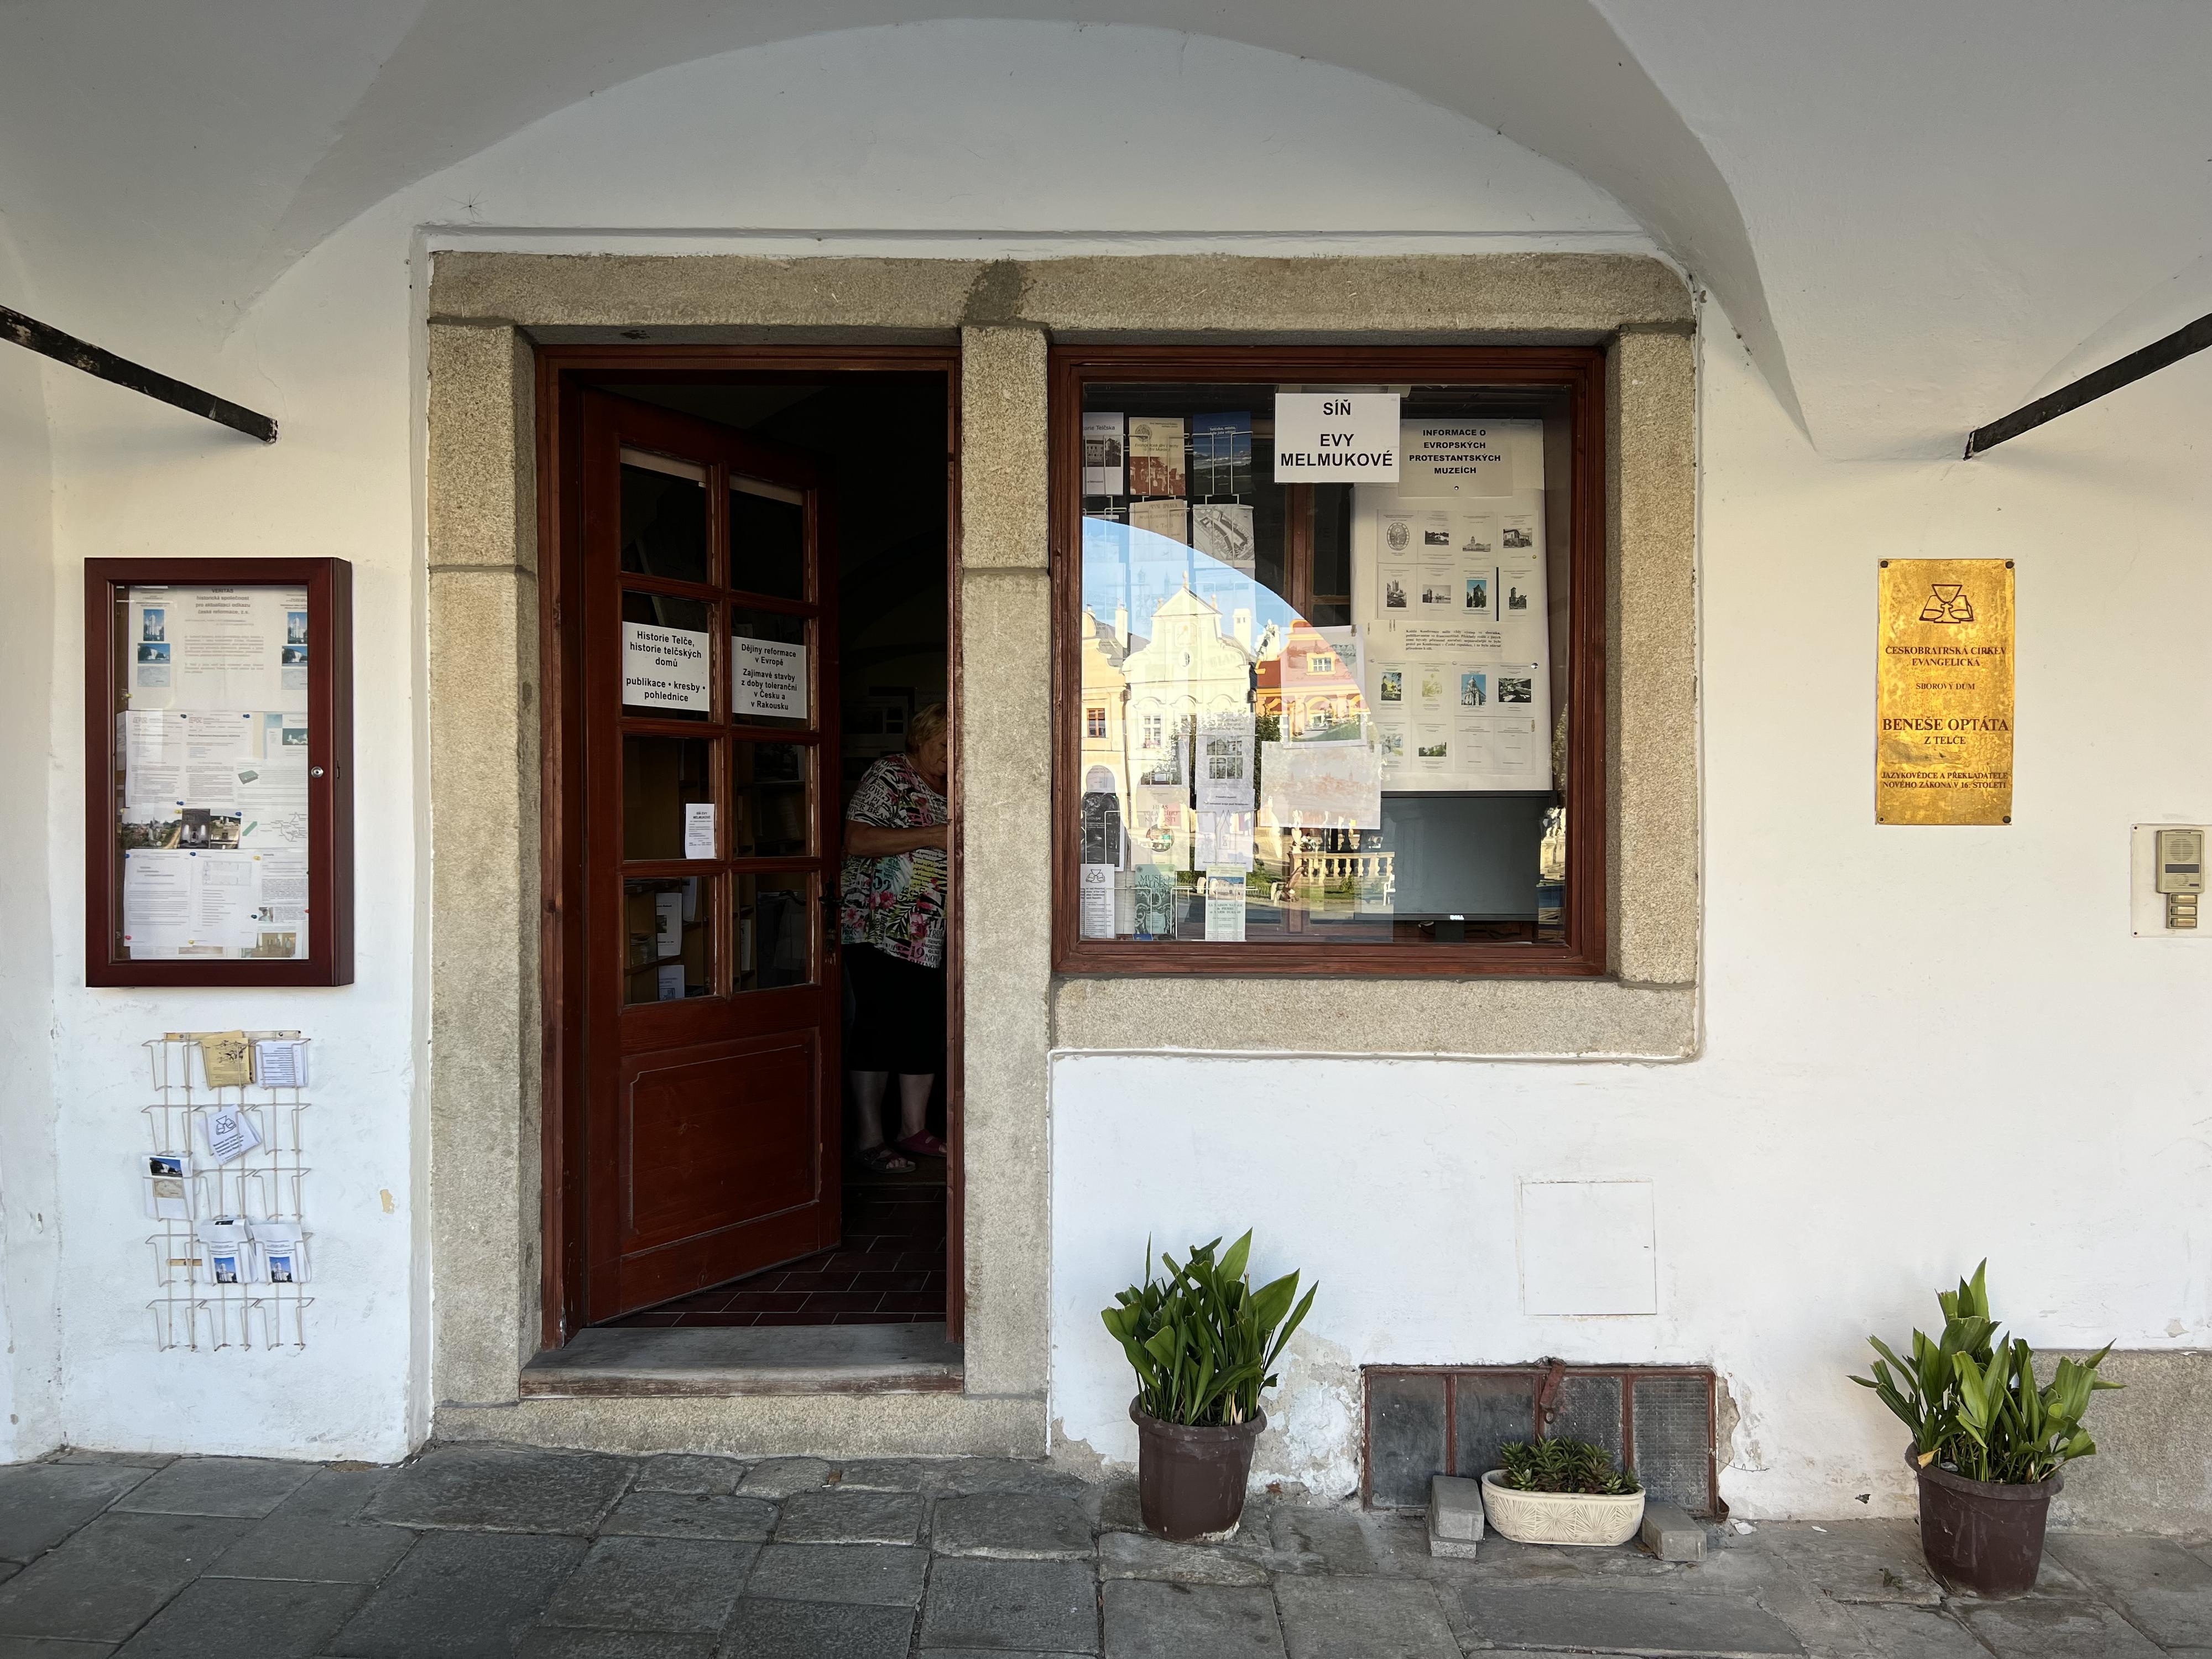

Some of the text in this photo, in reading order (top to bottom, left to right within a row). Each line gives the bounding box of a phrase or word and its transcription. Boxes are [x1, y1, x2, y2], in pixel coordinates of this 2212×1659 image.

[1323, 399, 1351, 415] SÍŇ
[1320, 434, 1354, 446] EVY
[1281, 450, 1392, 466] MELMUKOVÉ
[1434, 466, 1477, 474] MUZEÍCH
[637, 630, 695, 648] Historie Telče,
[630, 641, 702, 659] historie telčských
[741, 643, 796, 658] Dějiny reformace
[655, 657, 678, 667] domů
[761, 656, 784, 667] Evropě
[743, 668, 795, 683] Zajímavé stavby
[626, 677, 700, 693] publikace kresby
[747, 679, 763, 690] doby
[644, 691, 688, 702] pohlednice
[760, 689, 780, 700] Česku
[757, 700, 789, 710] Rakousku
[1882, 716, 2010, 731] BENEŠE OPTÁTA
[1924, 734, 1966, 744] Z TELČE
[1883, 780, 1917, 789] NOVÉHO
[1918, 780, 1952, 789] ZÁKONA
